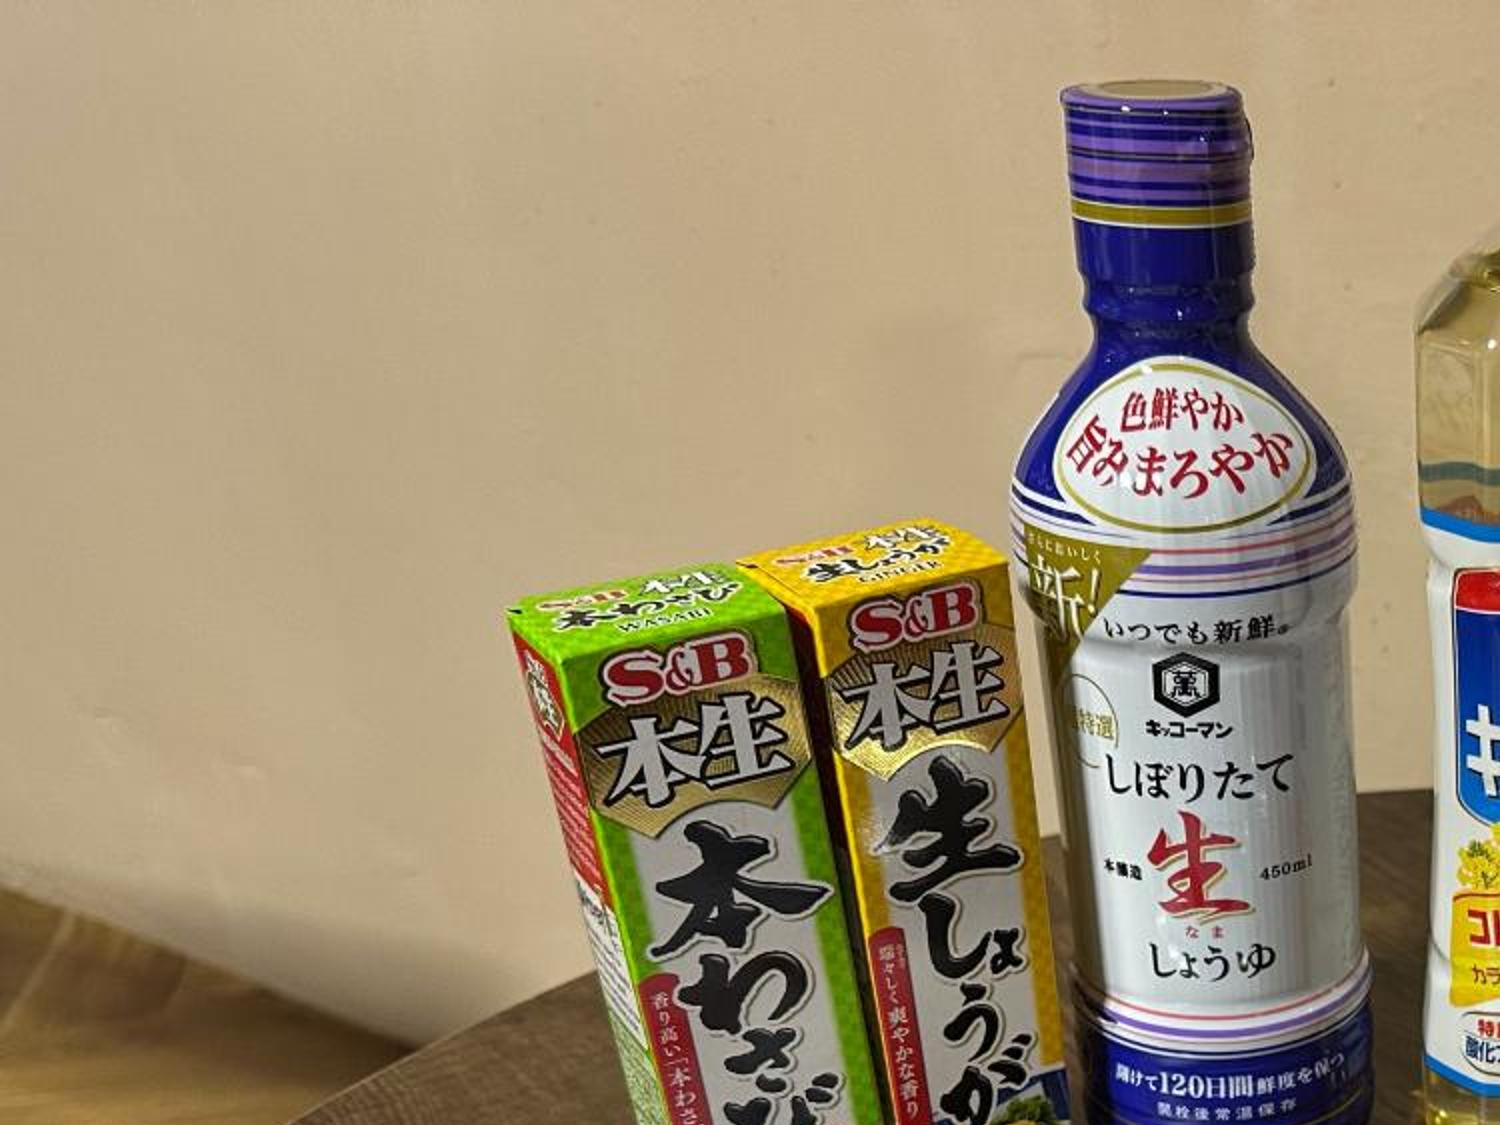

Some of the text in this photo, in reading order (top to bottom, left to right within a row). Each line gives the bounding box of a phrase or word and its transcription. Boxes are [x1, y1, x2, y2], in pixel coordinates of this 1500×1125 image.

[1120, 387, 1244, 432] 色鮮やか
[1065, 414, 1295, 499] 旨みまろやか
[618, 606, 713, 633] WASABI
[850, 583, 981, 651] S&B
[1103, 615, 1289, 646] いつでも新鮮。
[603, 631, 756, 706] S&B
[846, 640, 1010, 751] 本生
[596, 693, 793, 808] 本生
[1145, 719, 1234, 739] キッコーマン
[1105, 753, 1294, 803] しぼりたて
[1147, 810, 1253, 918] 生
[1260, 854, 1313, 881] 450ml
[1149, 943, 1276, 982] しょうゆ
